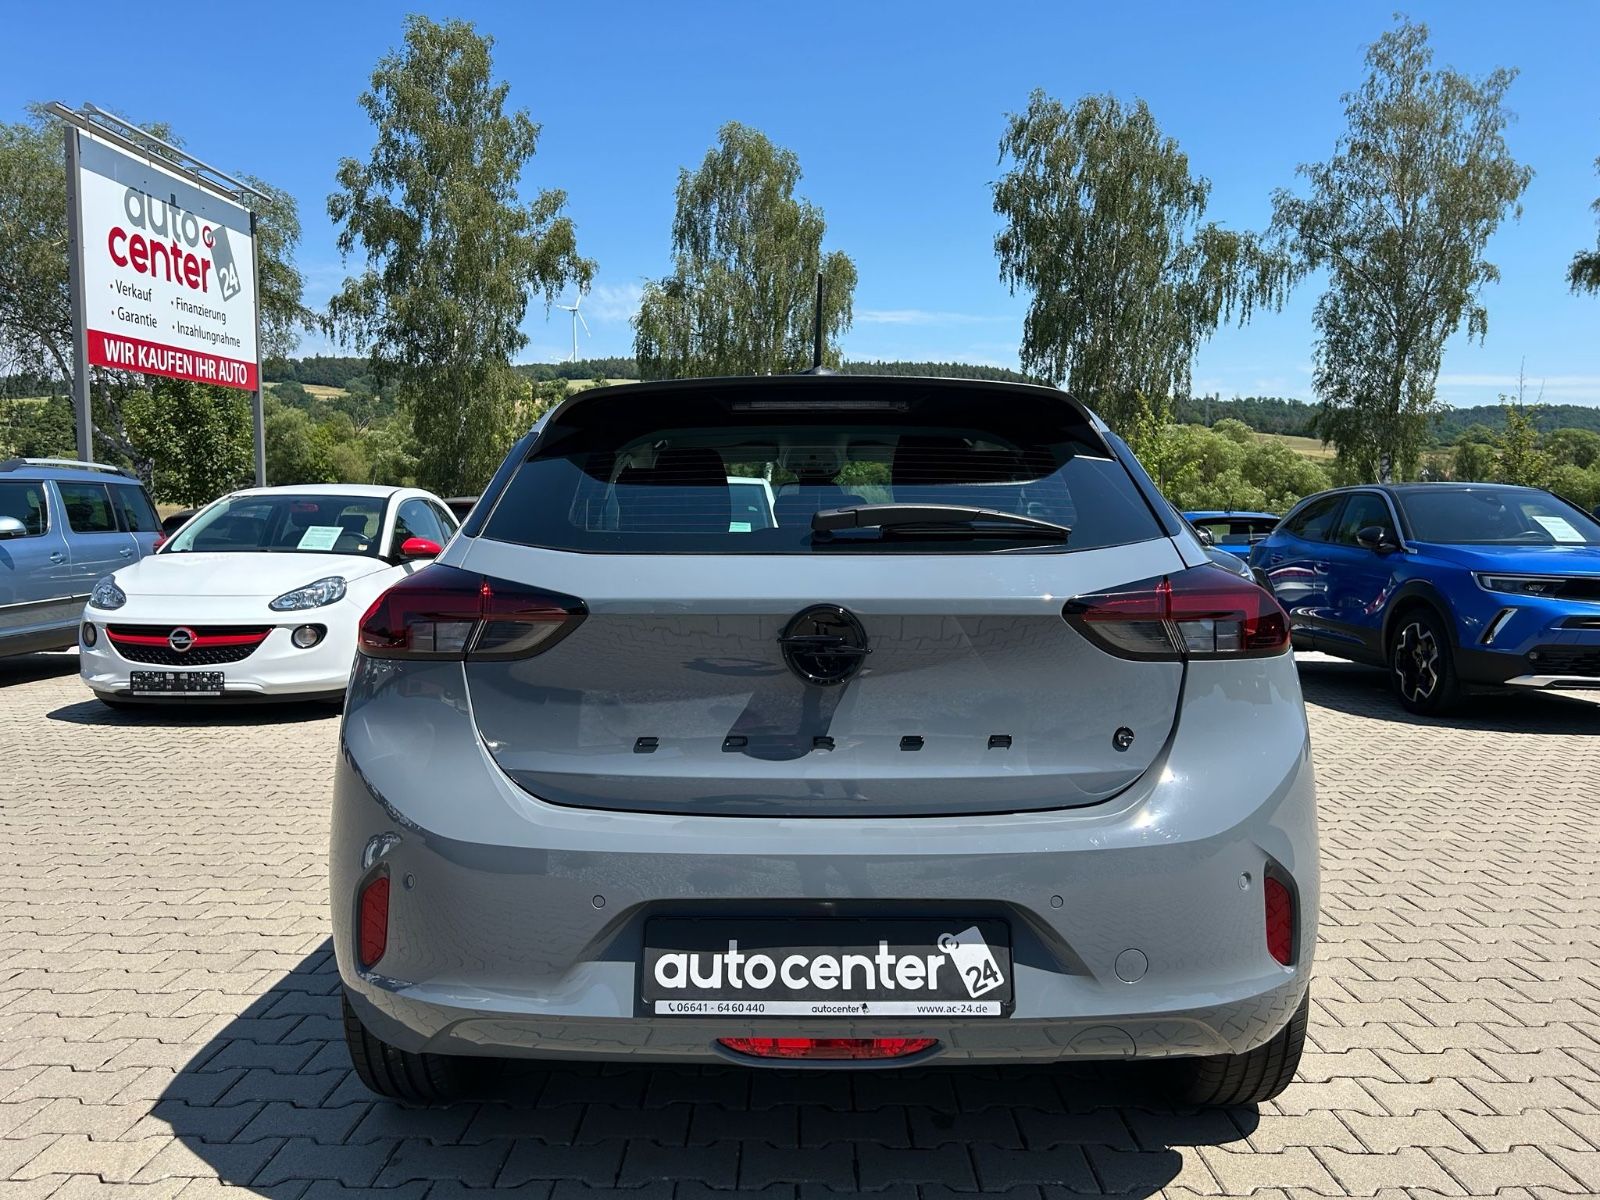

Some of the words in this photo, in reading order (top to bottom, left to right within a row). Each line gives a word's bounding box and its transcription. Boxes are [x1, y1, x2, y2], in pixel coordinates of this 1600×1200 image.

[124, 186, 200, 248] auto
[108, 226, 211, 293] center
[115, 279, 153, 302] Verkauf
[220, 265, 239, 297] 24
[117, 306, 158, 328] Garantie
[175, 296, 227, 325] Finanzierung
[176, 320, 241, 348] Inzahlungnahme
[103, 338, 135, 365] WIR
[138, 344, 193, 375] KAUFEN
[195, 355, 217, 379] IHR
[218, 361, 248, 385] AUTO
[654, 939, 945, 991] autocenter
[965, 958, 999, 994] 24
[811, 1002, 860, 1014] autocenter
[916, 1003, 988, 1014] www.ac-24.de
